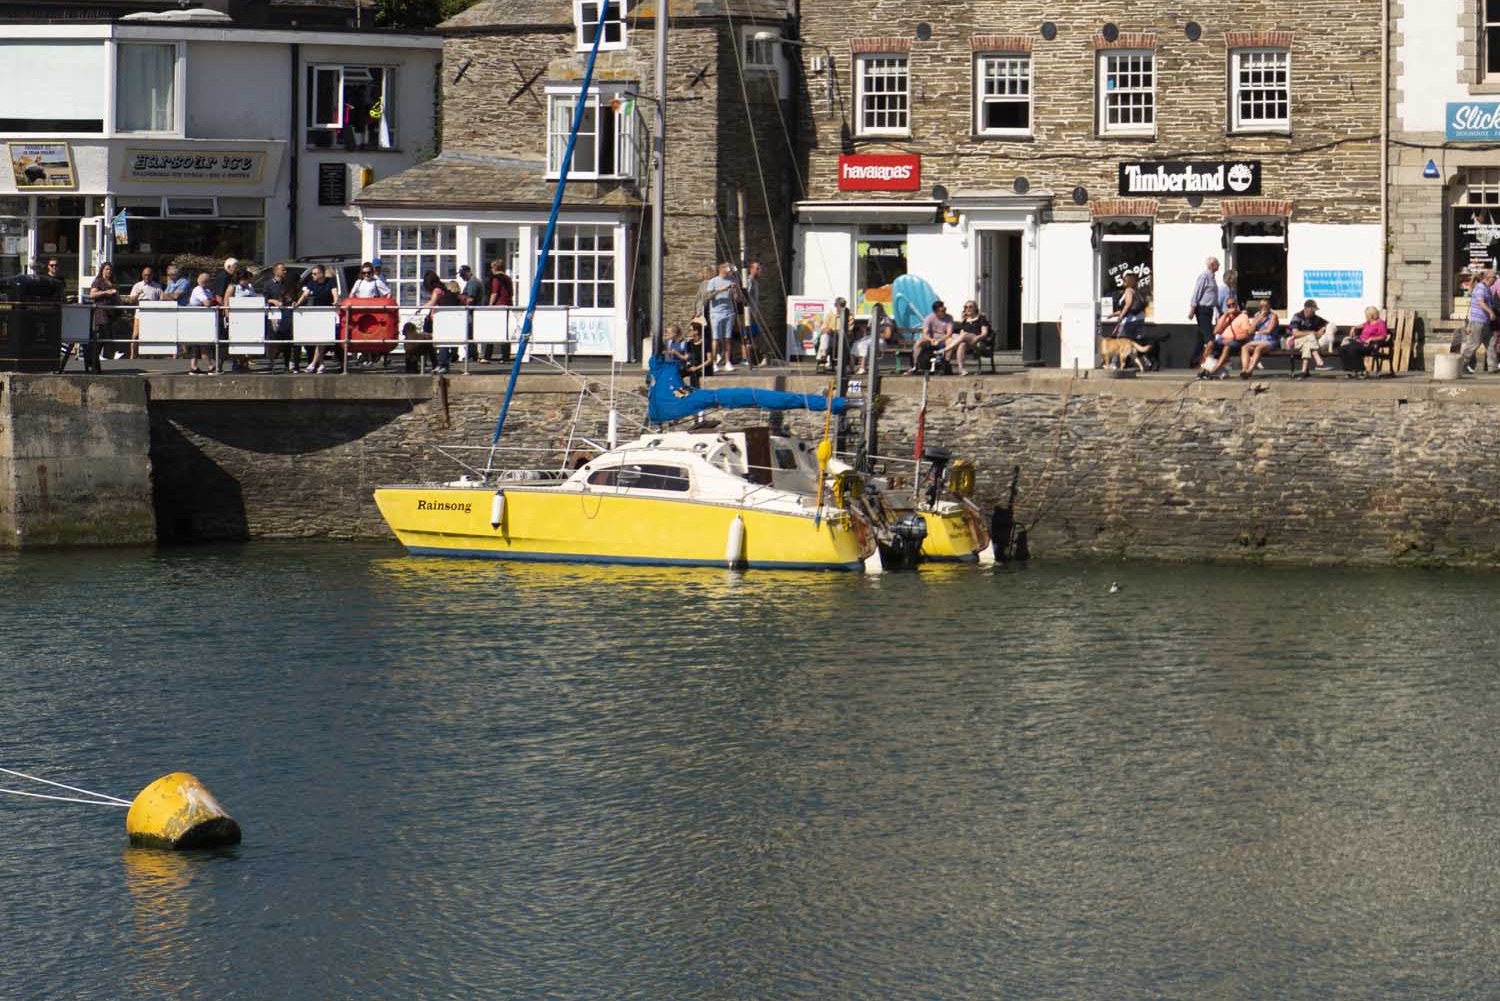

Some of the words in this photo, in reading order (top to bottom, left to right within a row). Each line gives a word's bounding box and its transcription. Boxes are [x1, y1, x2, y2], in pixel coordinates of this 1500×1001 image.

[843, 163, 913, 181] havaianas
[1124, 164, 1225, 192] Timberland
[1108, 266, 1118, 276] UP
[1118, 262, 1129, 271] TO
[417, 499, 472, 513] Rainsong
